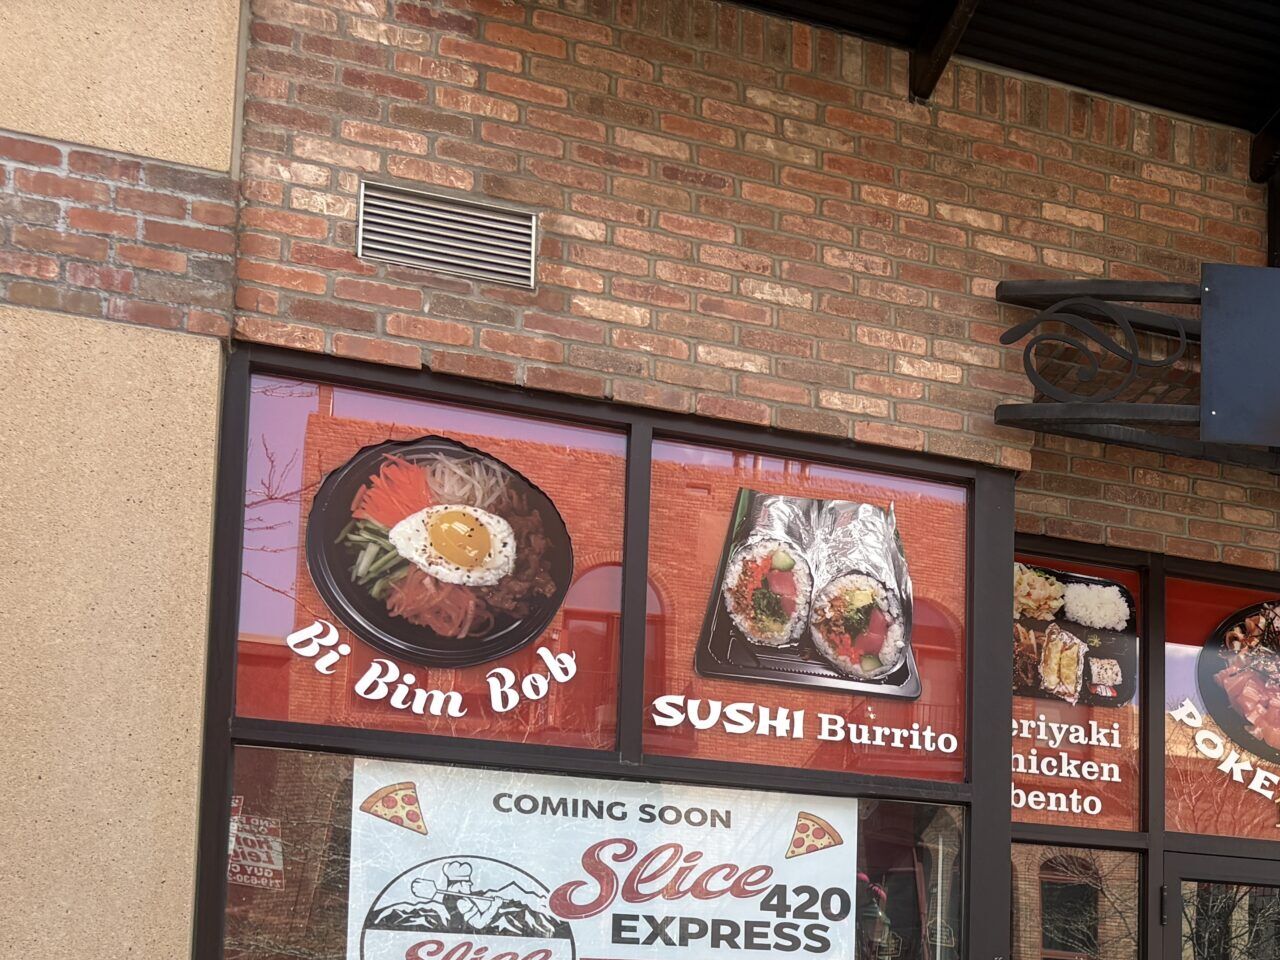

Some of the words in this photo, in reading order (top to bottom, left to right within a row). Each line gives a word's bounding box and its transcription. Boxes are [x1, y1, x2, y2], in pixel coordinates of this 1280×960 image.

[286, 619, 336, 675] Bi
[354, 659, 467, 718] Bim
[486, 646, 577, 714] Bob
[652, 696, 804, 739] SUSHI
[817, 711, 958, 753] Burrito
[1169, 698, 1280, 799] POKE
[493, 792, 628, 823] COMING
[638, 803, 732, 829] SOON
[1011, 782, 1102, 815] bento
[548, 837, 774, 920] Slice
[759, 884, 851, 922] 420
[611, 913, 832, 954] EXPRESS
